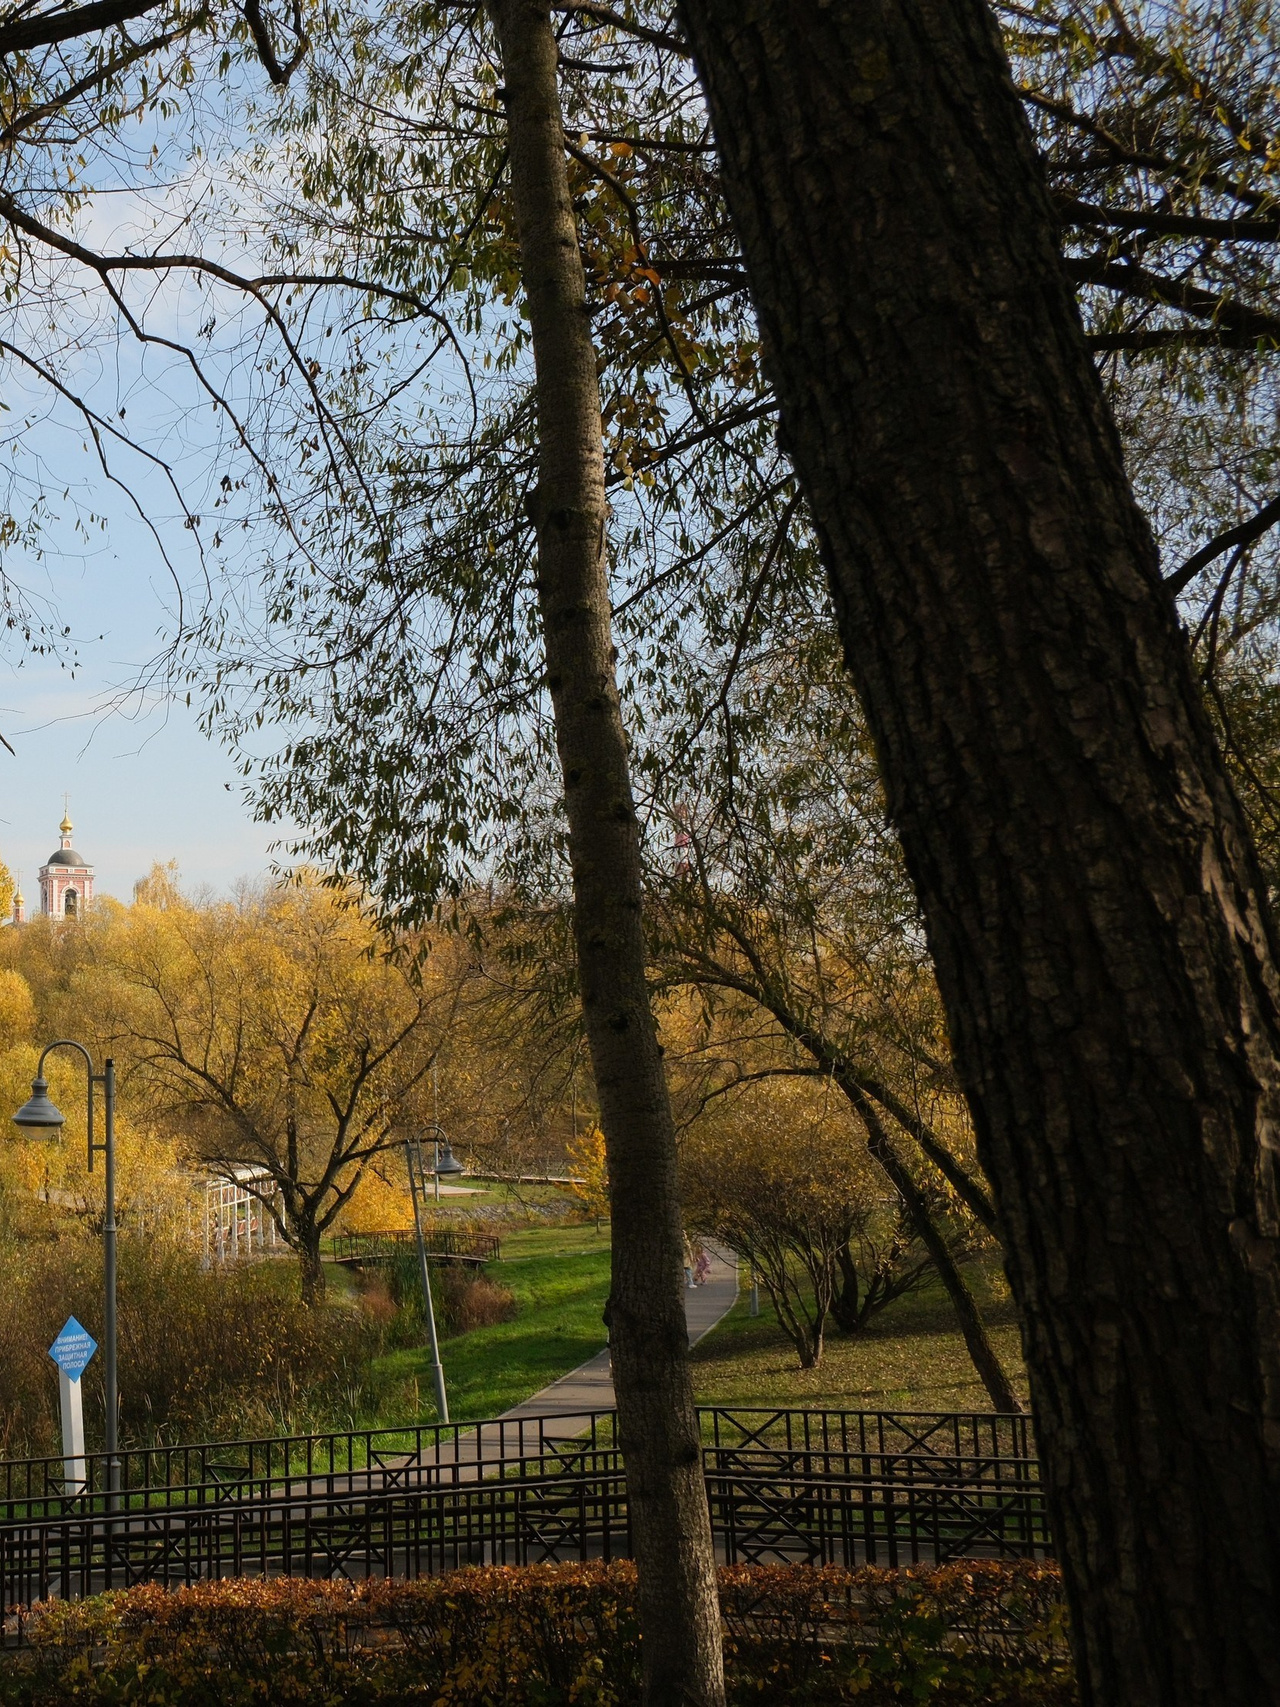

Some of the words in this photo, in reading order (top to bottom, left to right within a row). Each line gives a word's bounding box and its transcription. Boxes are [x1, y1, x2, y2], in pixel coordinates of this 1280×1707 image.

[55, 1342, 91, 1353] ПРИБРЕЖНАЯ
[59, 1351, 87, 1361] ЗАЩИТНАЯ
[63, 1360, 85, 1370] ПОЛОСА
